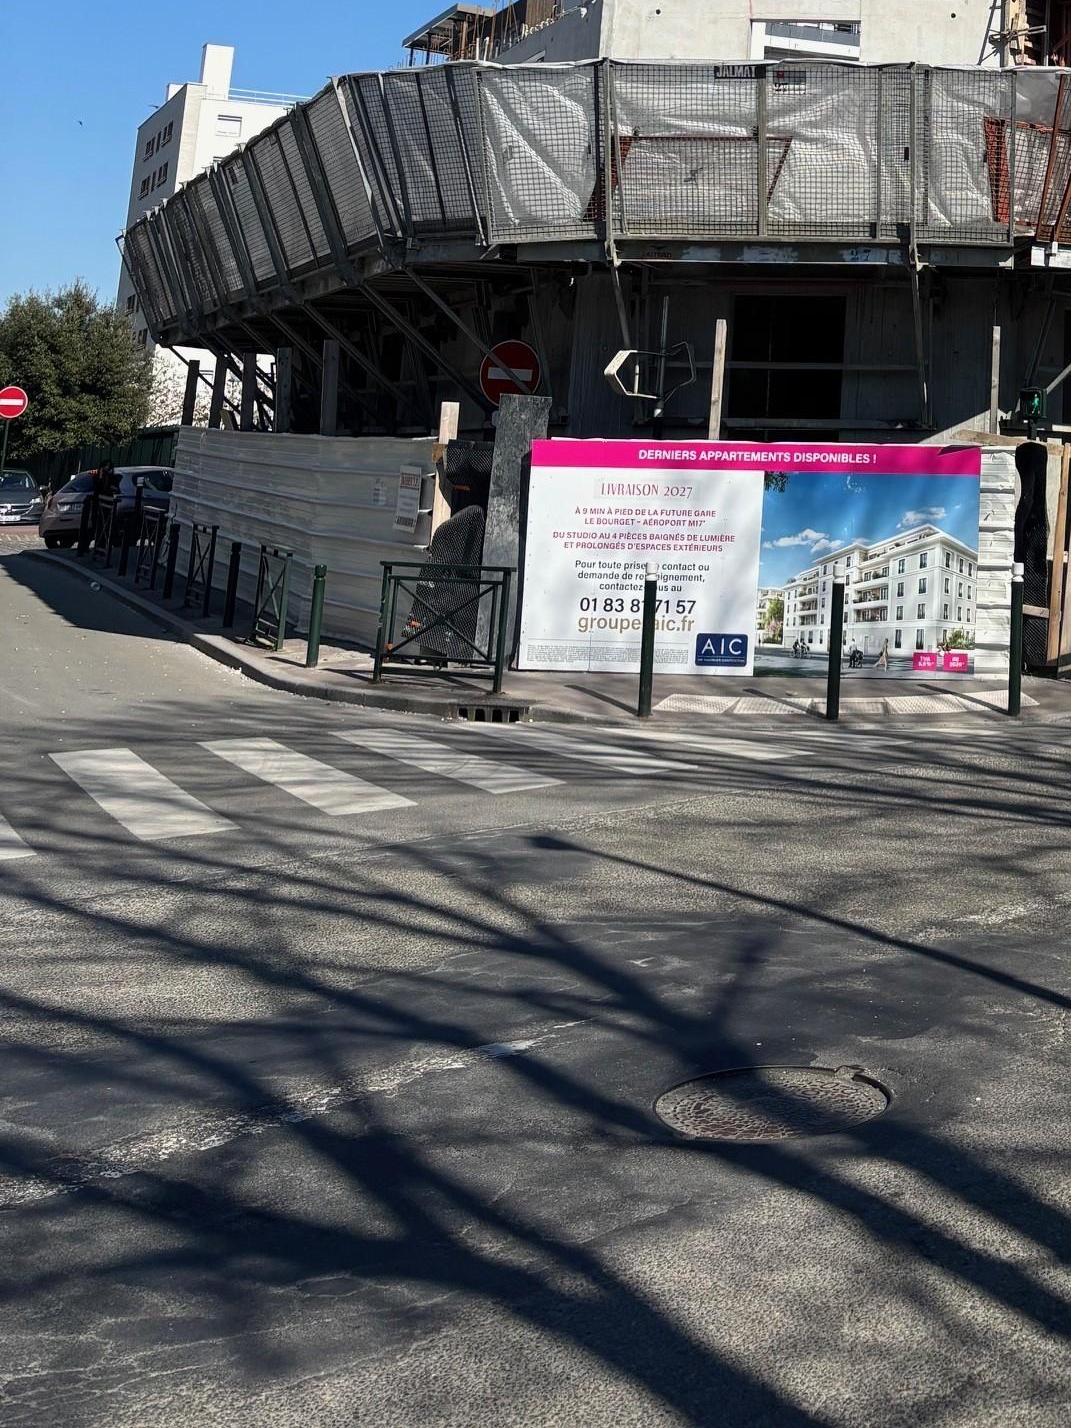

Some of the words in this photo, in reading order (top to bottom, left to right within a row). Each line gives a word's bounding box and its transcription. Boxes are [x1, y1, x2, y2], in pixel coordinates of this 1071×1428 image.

[716, 65, 757, 78] JALMAT
[638, 449, 697, 461] DERNIERS
[699, 450, 791, 463] APPARTEMENTS
[793, 452, 870, 464] DISPONIBLES
[601, 483, 659, 496] LIVRAISON
[663, 486, 693, 499] 2027
[575, 506, 581, 514] À
[589, 507, 605, 515] MIN
[607, 506, 613, 515] À
[614, 508, 633, 516] PIED
[635, 508, 646, 516] DE
[660, 509, 692, 517] FUTURE
[694, 510, 716, 518] GARE
[584, 517, 594, 525] LE
[596, 517, 635, 526] BOURGET
[642, 518, 686, 526] AÉROPORT
[552, 531, 565, 539] DU
[566, 531, 597, 539] STUDIO
[619, 531, 648, 540] PIÈCES
[649, 532, 685, 541] BAIGNÉS
[686, 534, 698, 542] DE
[699, 533, 736, 542] LUMIÈRE
[564, 541, 574, 549] ET
[575, 541, 626, 550] PROLONGÉS
[627, 542, 671, 551] D'ESPACES
[673, 543, 723, 552] EXTÉRIEURS
[575, 560, 597, 569] Pour
[598, 560, 622, 569] toute
[623, 561, 646, 572] prise
[661, 562, 697, 571] contact
[577, 571, 620, 580] demande
[621, 571, 633, 580] de
[579, 597, 597, 612] 01
[603, 598, 625, 613] 83
[630, 598, 645, 613] 8
[655, 599, 670, 614] 71
[675, 600, 697, 614] 57
[701, 637, 743, 655] AIC
